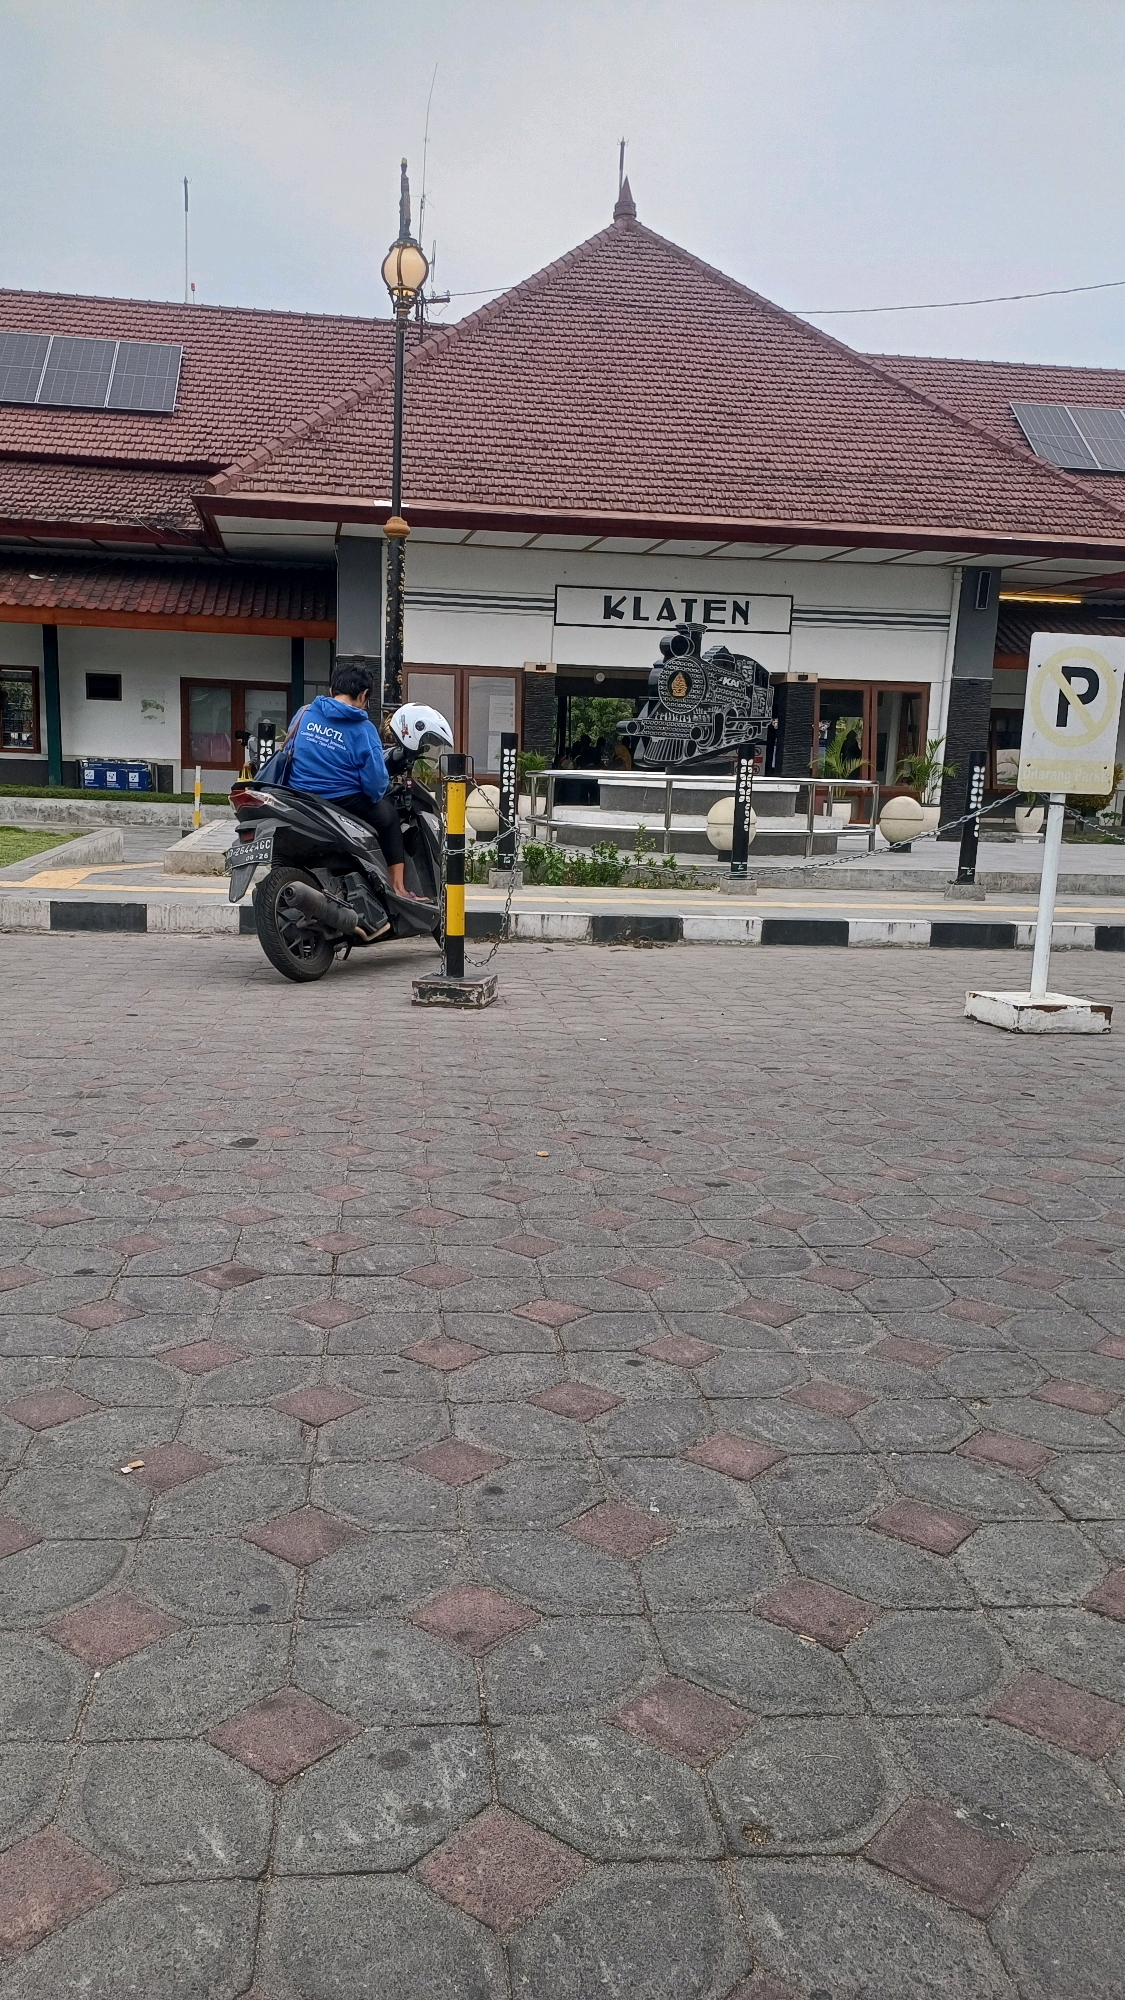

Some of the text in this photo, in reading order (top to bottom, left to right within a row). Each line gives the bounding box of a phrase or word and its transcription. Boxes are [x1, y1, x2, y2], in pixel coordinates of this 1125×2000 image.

[603, 595, 749, 625] KLATEN
[722, 676, 740, 688] KAI
[1056, 666, 1099, 727] P
[306, 722, 344, 743] CNJCTL
[1022, 768, 1071, 784] Dilarang
